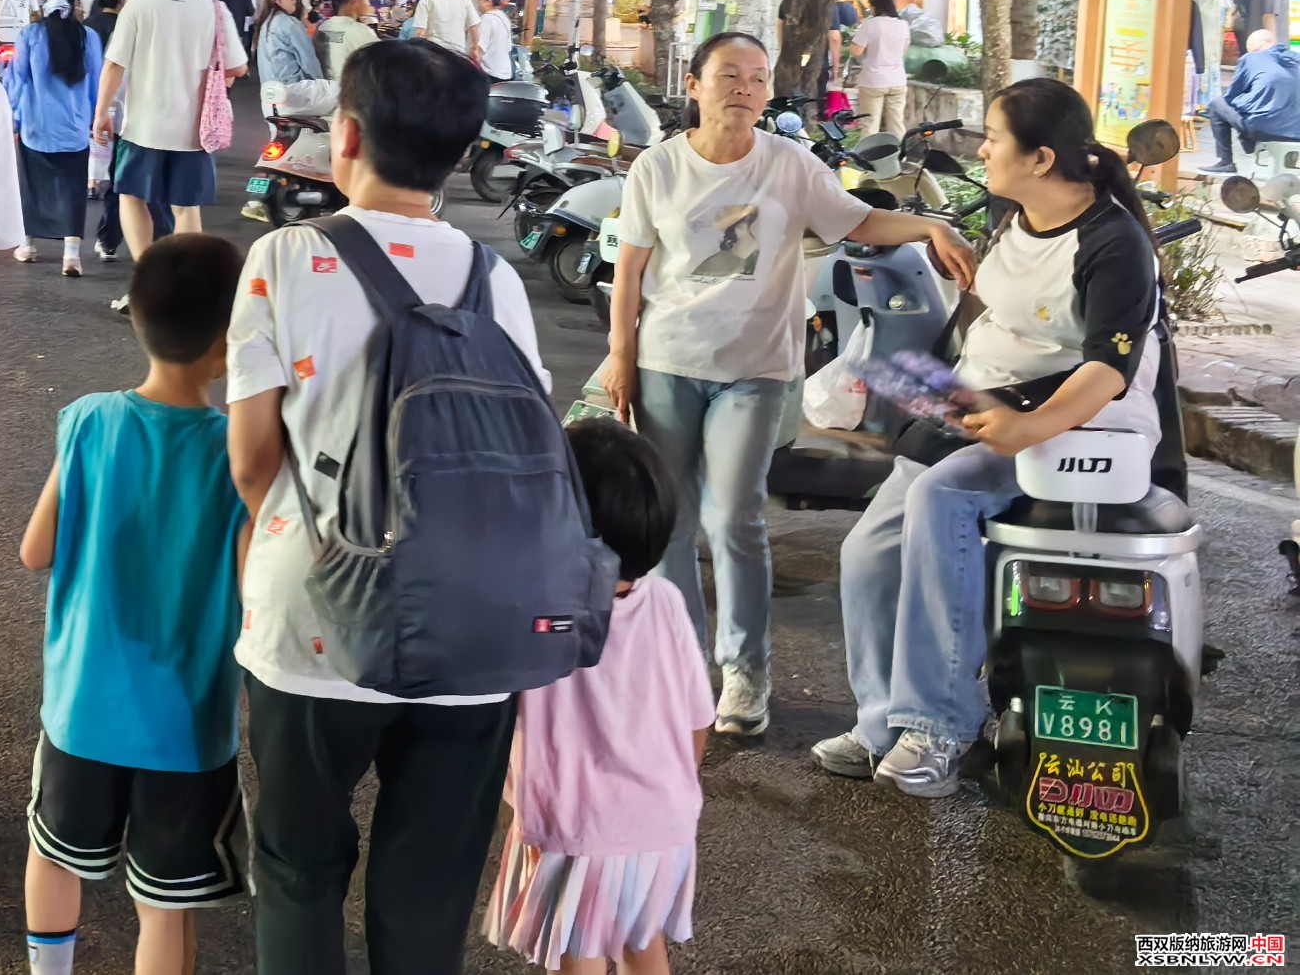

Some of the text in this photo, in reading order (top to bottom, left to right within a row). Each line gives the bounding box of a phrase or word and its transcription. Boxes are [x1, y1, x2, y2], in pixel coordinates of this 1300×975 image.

[1058, 694, 1113, 716] 云 K
[1042, 712, 1127, 743] V8981
[1044, 754, 1127, 788] 云汕公司
